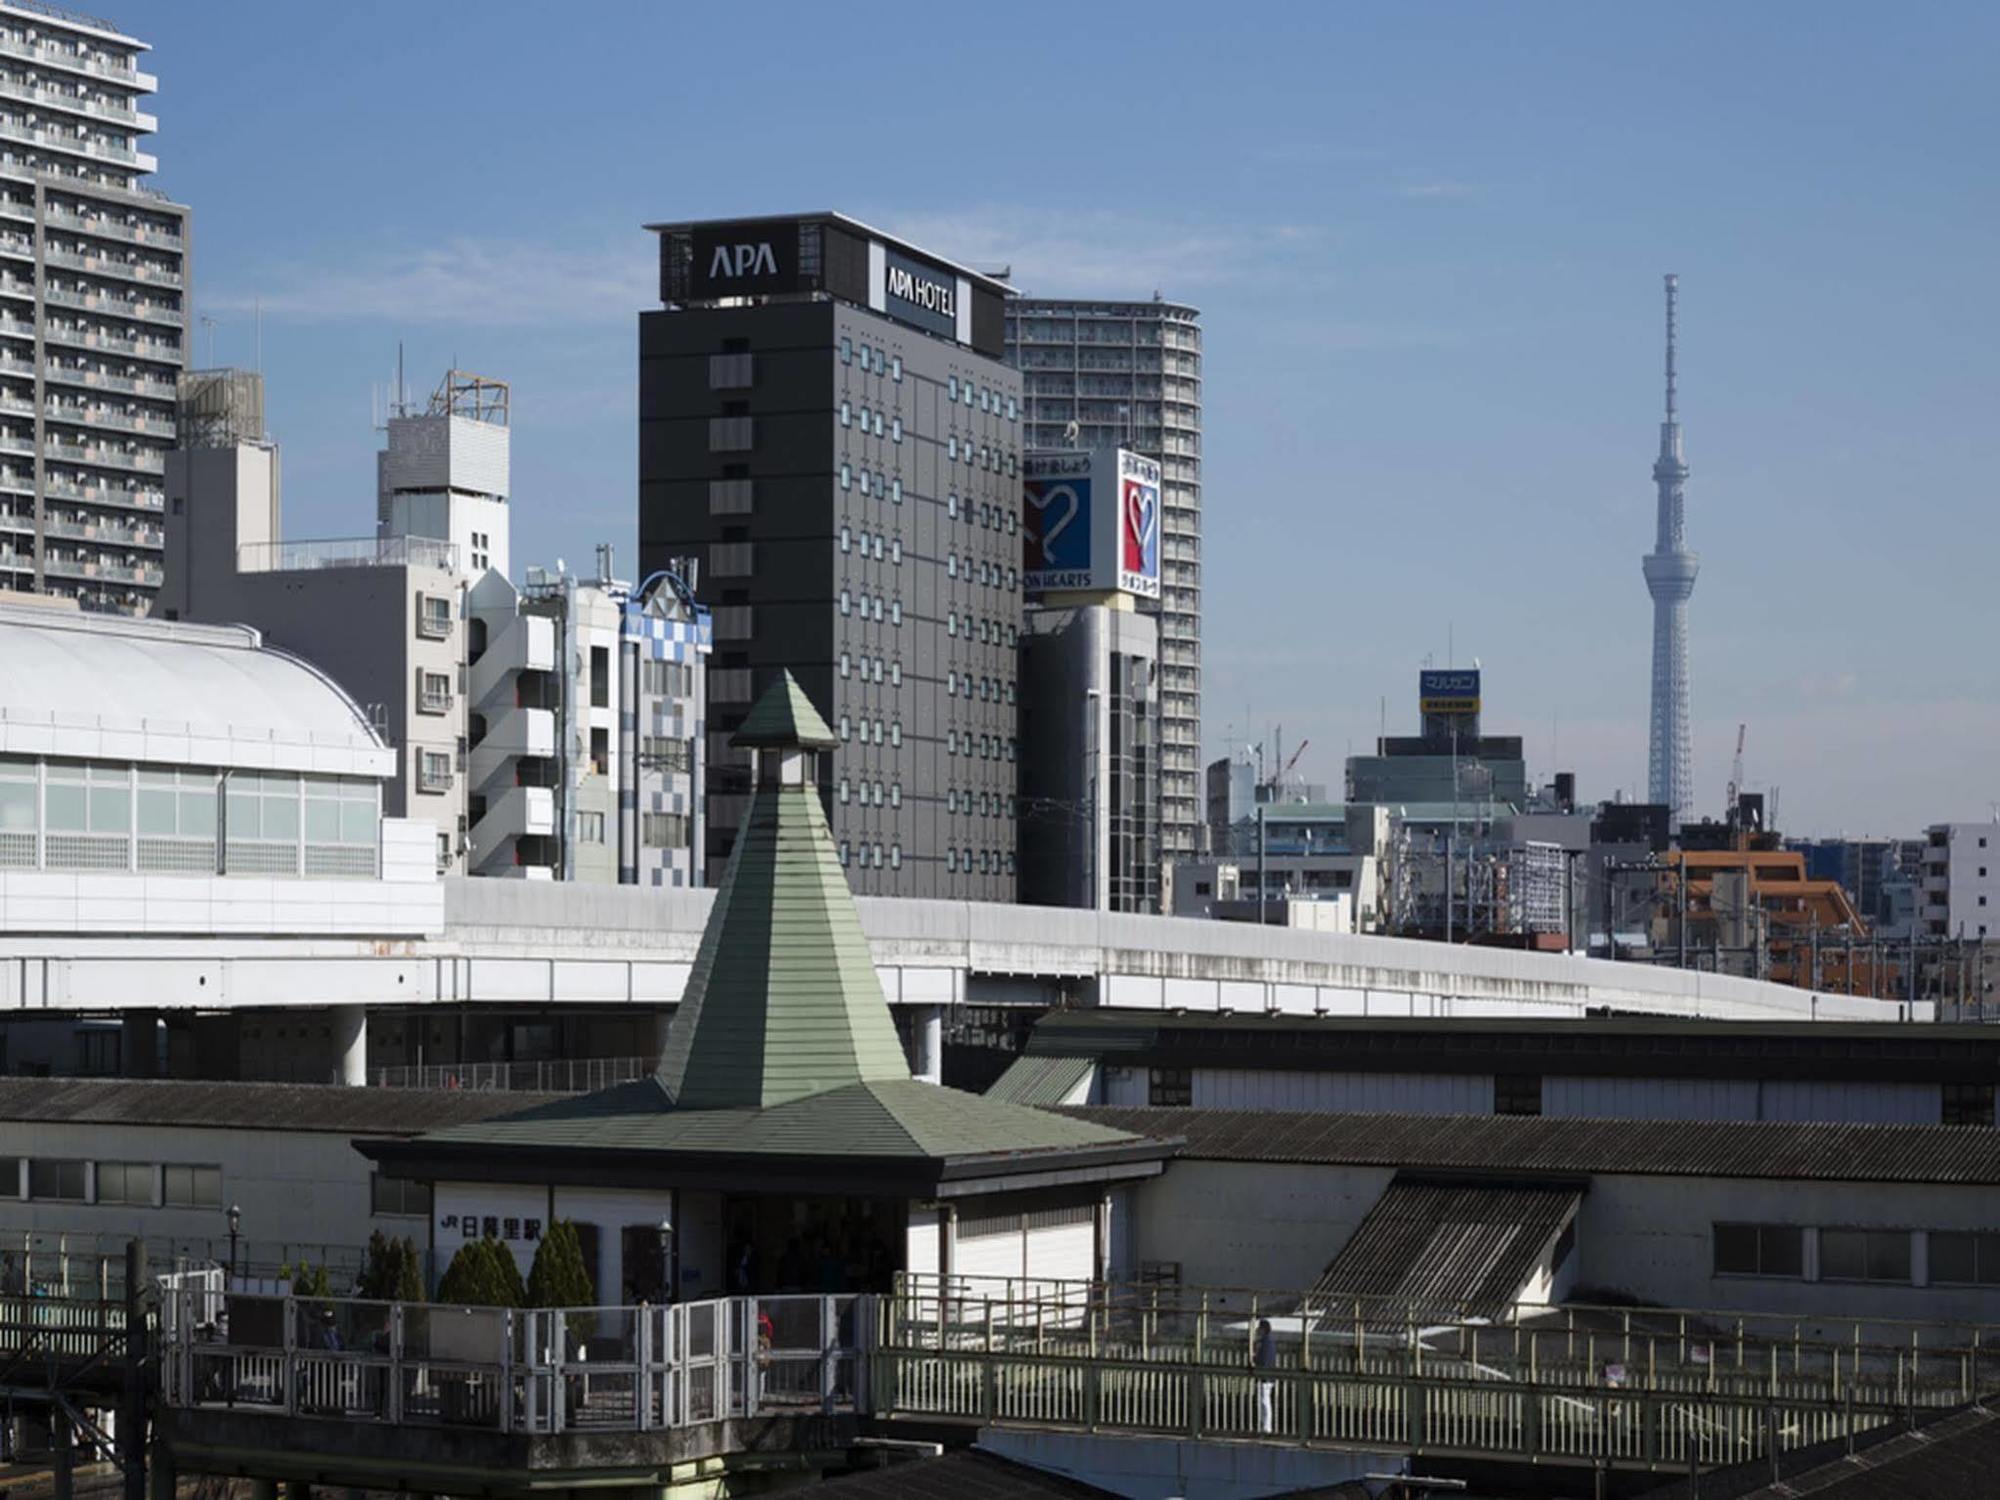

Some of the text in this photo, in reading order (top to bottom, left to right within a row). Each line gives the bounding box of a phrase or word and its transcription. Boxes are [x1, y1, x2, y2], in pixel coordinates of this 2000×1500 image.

[709, 243, 778, 278] APA
[887, 267, 956, 318] APA HOTEL
[1043, 572, 1091, 587] HEARTS
